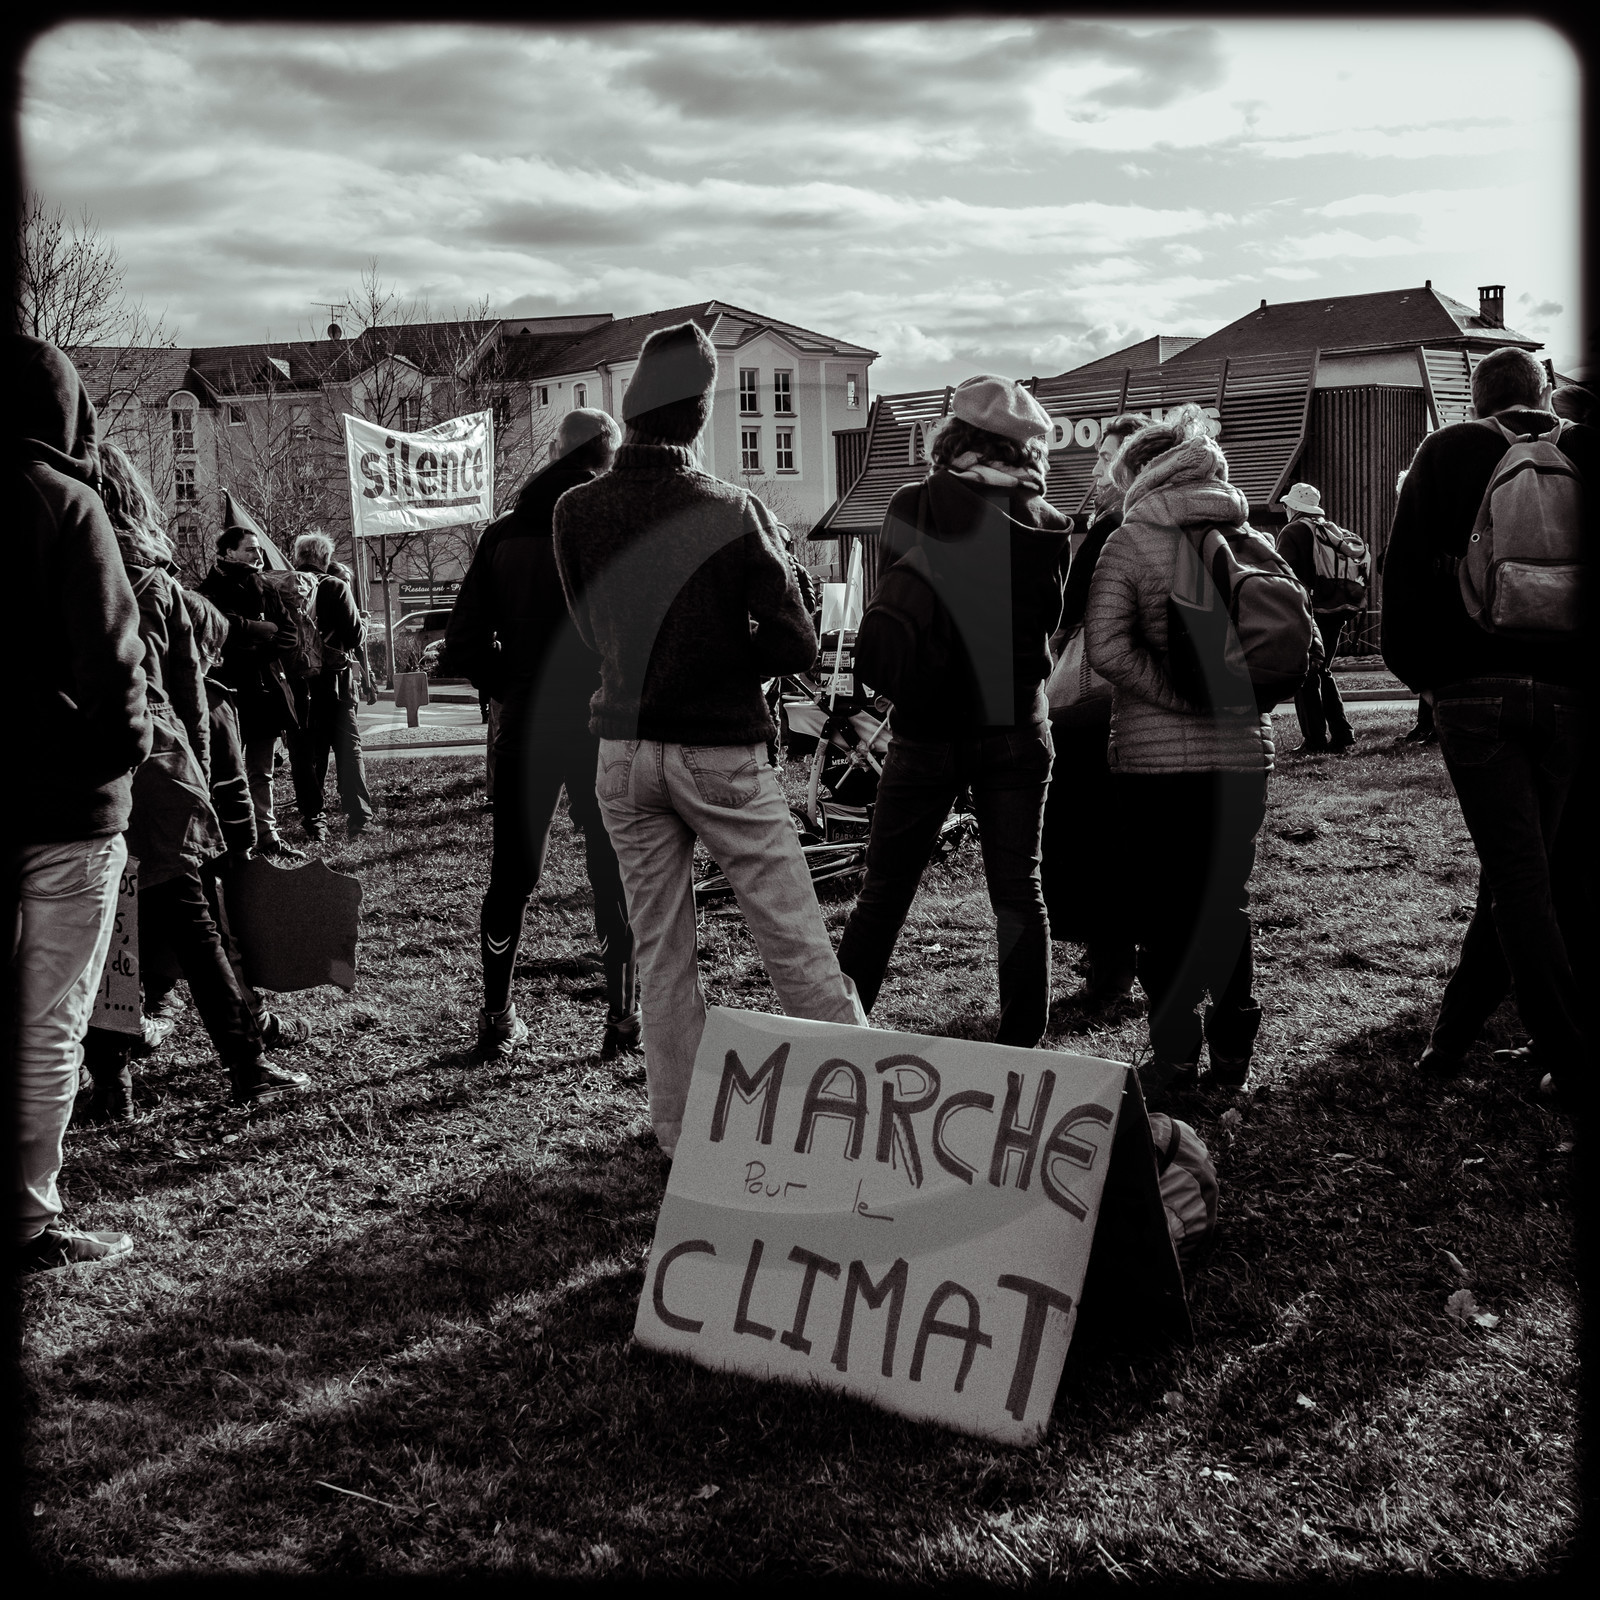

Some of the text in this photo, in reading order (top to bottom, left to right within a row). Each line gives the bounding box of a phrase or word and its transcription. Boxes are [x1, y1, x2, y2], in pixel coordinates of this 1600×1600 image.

[360, 434, 484, 499] silence
[401, 584, 445, 593] Restauant
[709, 1041, 1115, 1222] MARCHE
[852, 1178, 894, 1221] le
[652, 1237, 1075, 1422] CLIMAT
